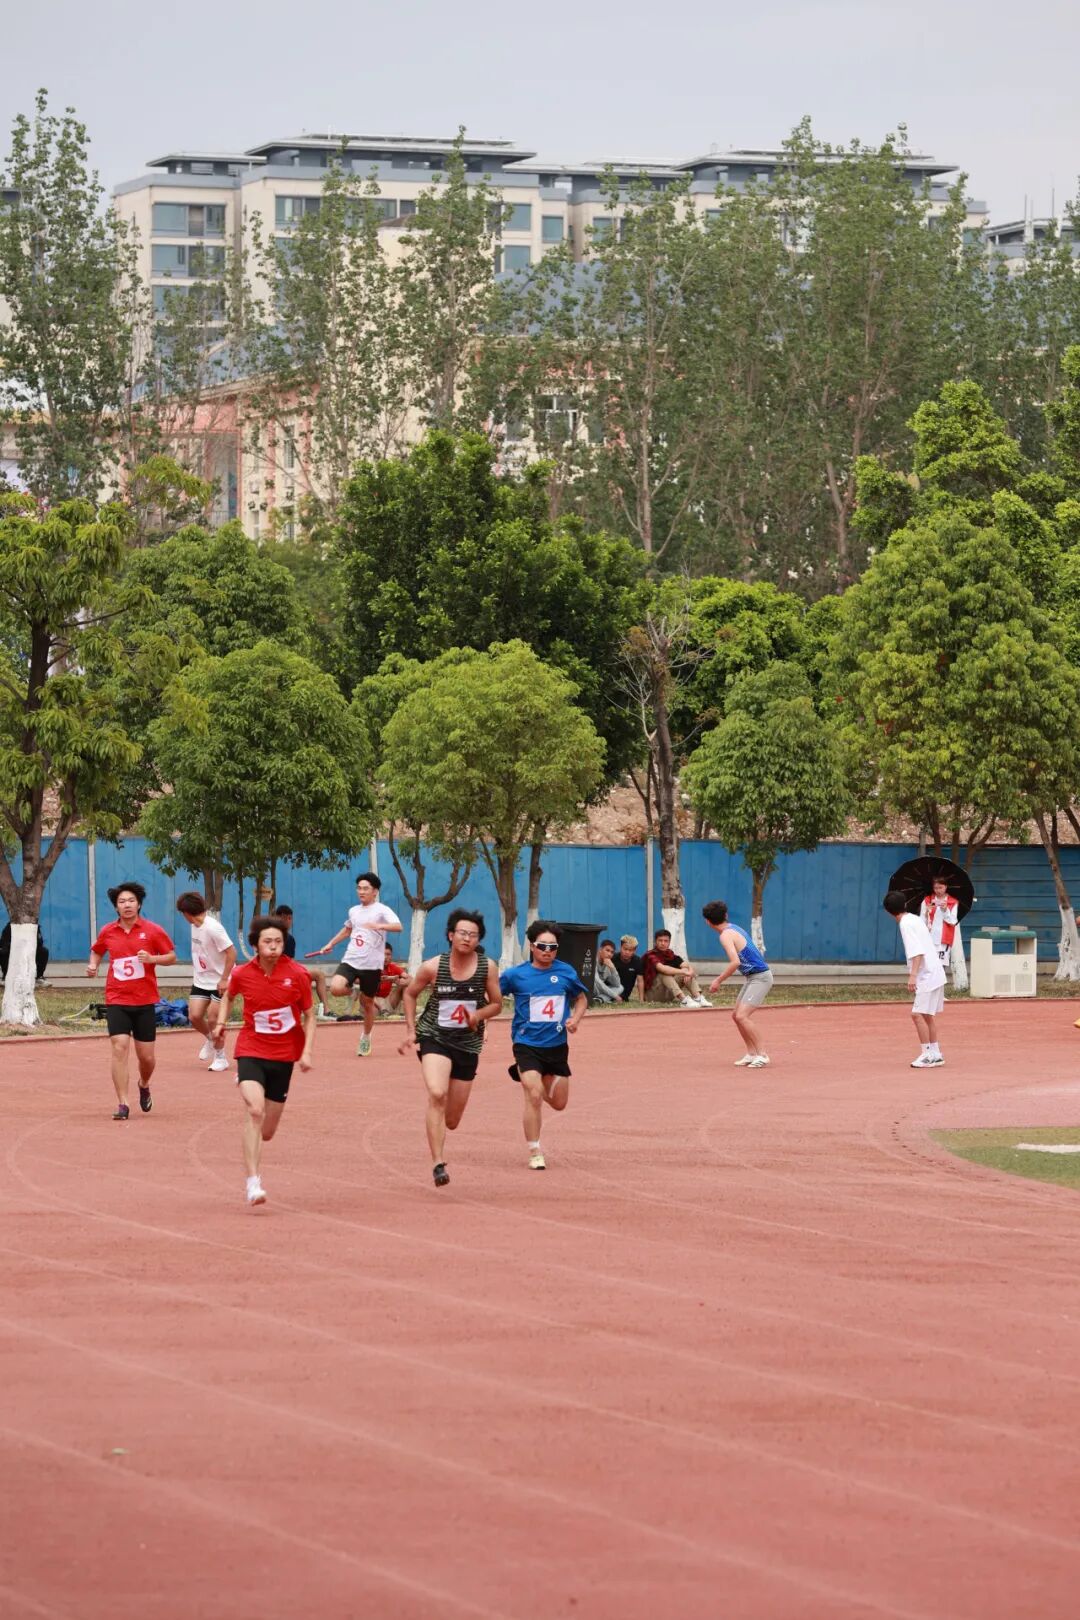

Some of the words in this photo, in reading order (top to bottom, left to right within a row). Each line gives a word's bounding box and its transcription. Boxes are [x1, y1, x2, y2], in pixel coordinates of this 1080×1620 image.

[355, 934, 364, 947] 6
[123, 960, 135, 977] 5
[450, 1004, 465, 1024] 4
[541, 1000, 555, 1018] 4
[268, 1012, 283, 1031] 5
